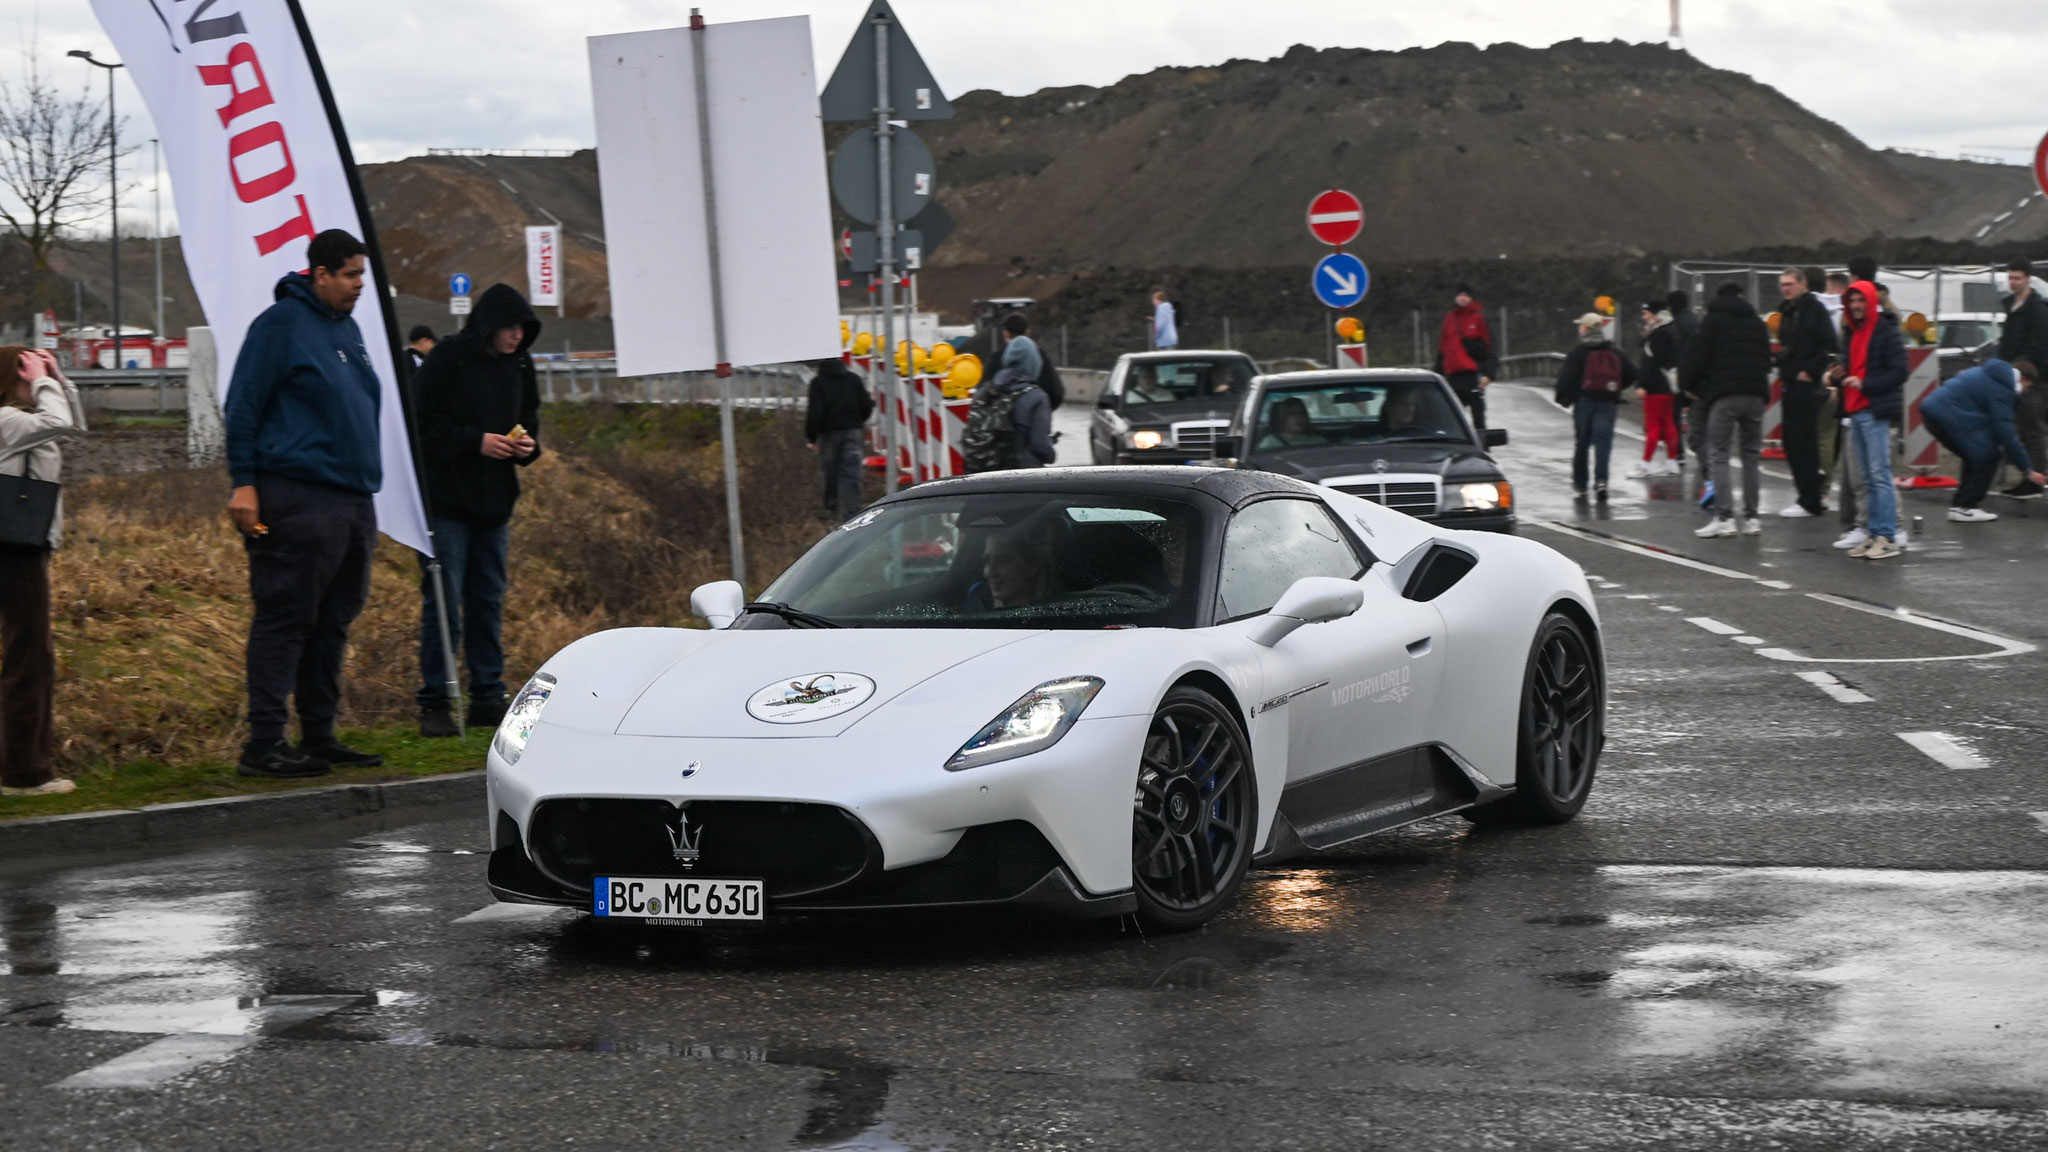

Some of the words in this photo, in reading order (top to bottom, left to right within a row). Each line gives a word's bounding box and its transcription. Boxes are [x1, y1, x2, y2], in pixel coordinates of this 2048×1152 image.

[1330, 666, 1410, 707] MOTORWORLD
[598, 901, 605, 910] D
[611, 882, 645, 913] BC
[664, 883, 701, 914] MC
[706, 884, 760, 916] 630
[645, 918, 703, 927] MOTORWORLD
